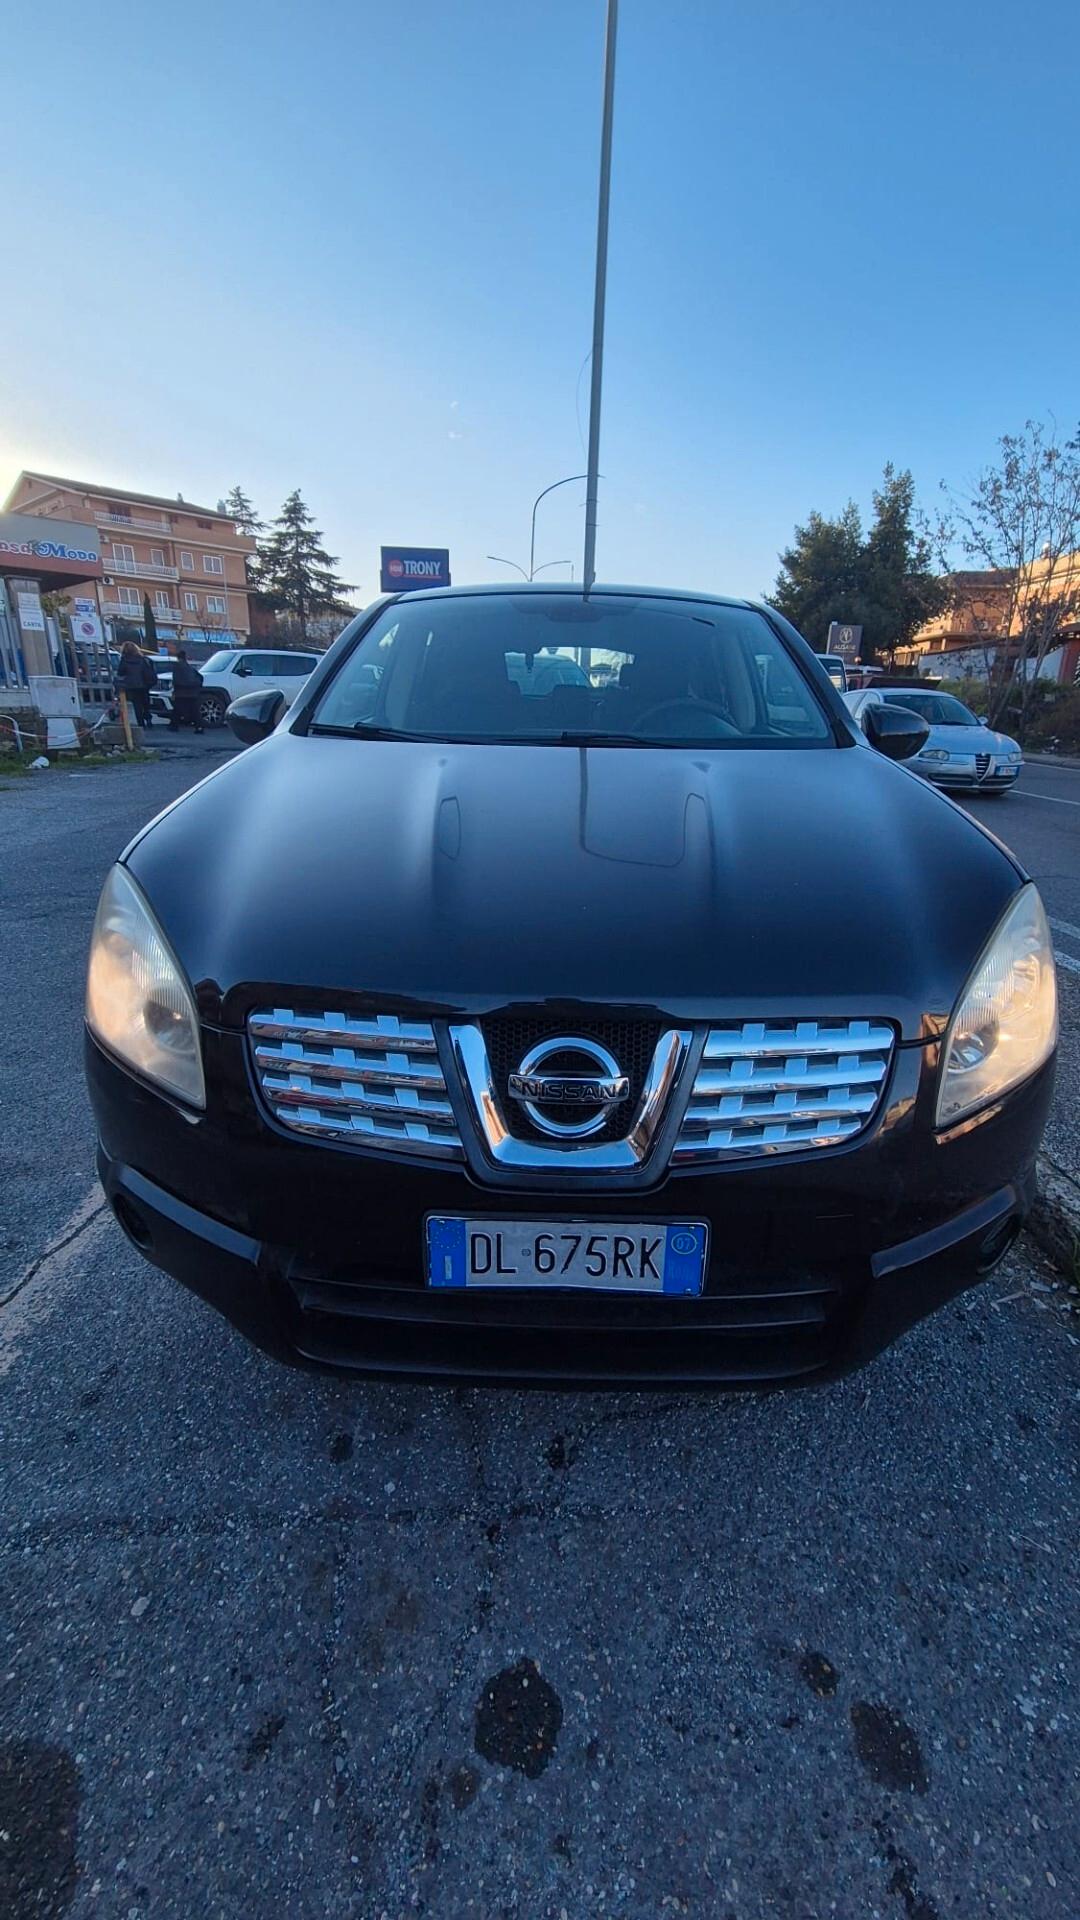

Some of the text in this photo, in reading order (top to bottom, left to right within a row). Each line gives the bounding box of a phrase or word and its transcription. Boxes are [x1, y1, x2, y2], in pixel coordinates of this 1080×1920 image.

[404, 560, 441, 575] TRONY
[521, 1082, 617, 1100] NISSAN
[470, 1232, 517, 1275] DL
[534, 1233, 664, 1280] 675RK
